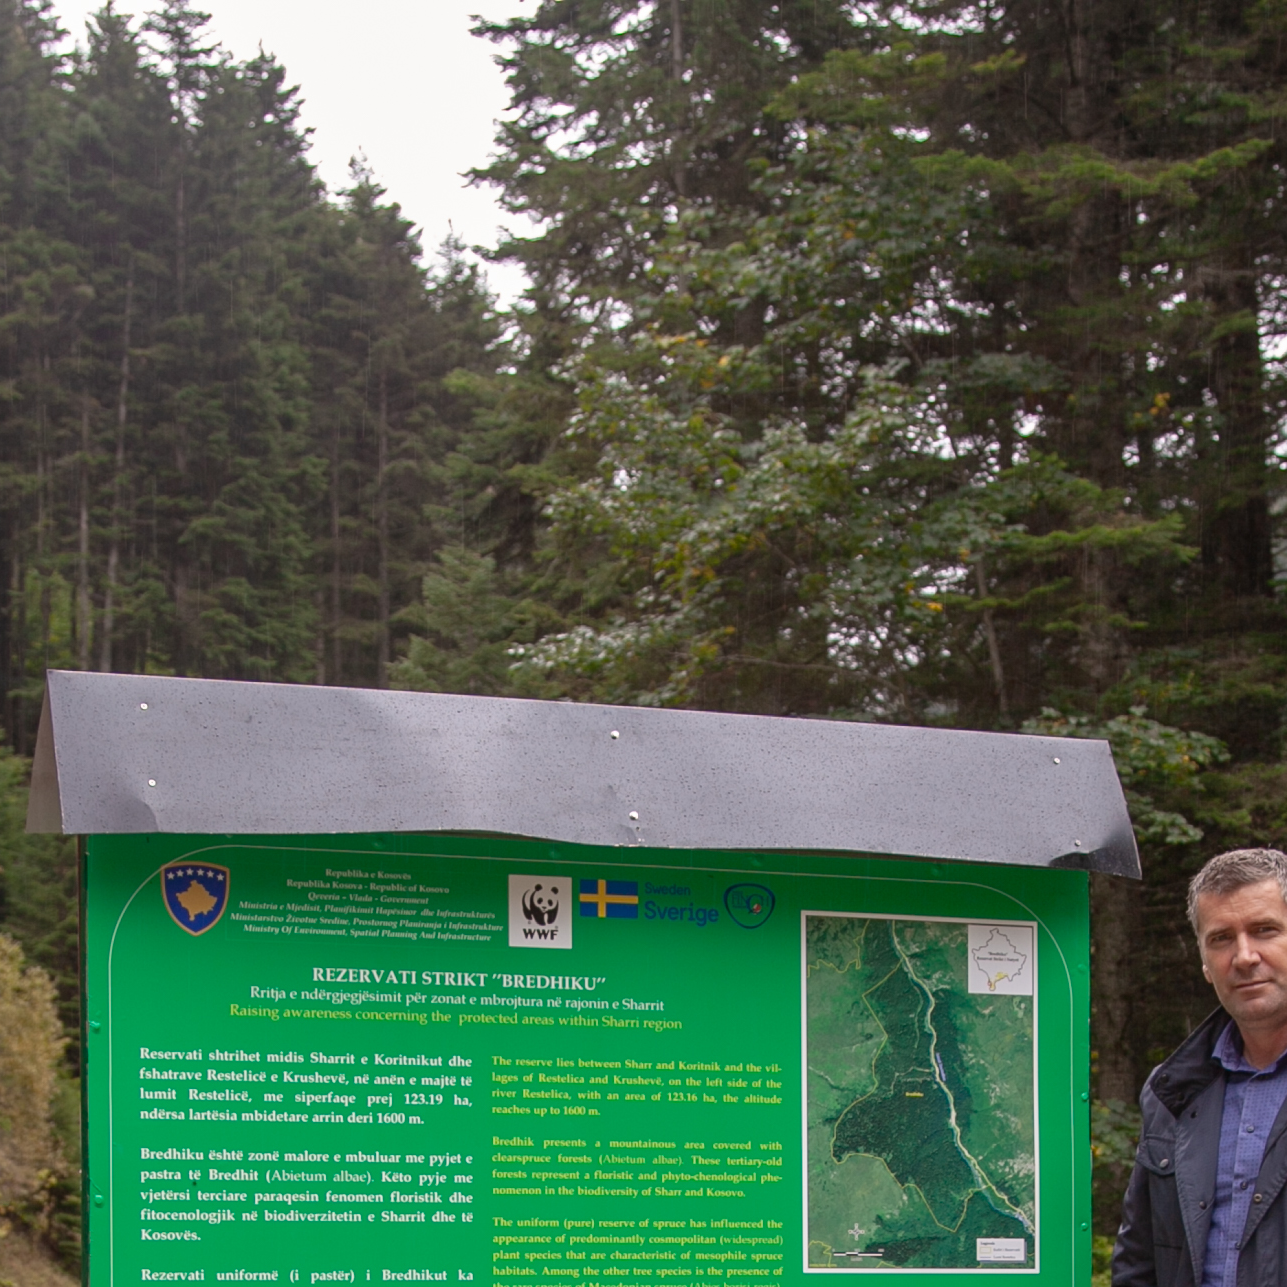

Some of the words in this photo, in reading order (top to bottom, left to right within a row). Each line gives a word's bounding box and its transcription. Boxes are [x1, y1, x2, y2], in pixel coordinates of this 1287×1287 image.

[644, 882, 691, 897] Sweden
[644, 901, 720, 927] Sverige
[522, 928, 559, 941] WWF
[312, 967, 416, 984] REZERVATI
[421, 970, 487, 986] STRIKT
[250, 985, 285, 1001] Rritja
[289, 990, 297, 999] e
[300, 987, 401, 1005] ndërgjegjësimit
[405, 992, 427, 1006] për
[430, 994, 465, 1004] zonat
[469, 996, 477, 1004] e
[480, 993, 543, 1009] mbrojtura
[546, 996, 561, 1007] në
[565, 999, 609, 1011] rajonin
[611, 1000, 619, 1009] e
[621, 998, 663, 1010] Sharrit
[229, 1003, 279, 1020] Raising
[282, 1008, 352, 1019] awareness
[355, 1010, 427, 1025] concerning
[431, 1009, 451, 1022] the
[458, 1012, 517, 1026] protected
[521, 1015, 554, 1025] areas
[558, 1014, 598, 1026] within
[601, 1015, 639, 1027] Sharri
[643, 1019, 682, 1032] region
[139, 1047, 202, 1060] Reservati
[208, 1048, 260, 1062] shtrihet
[266, 1051, 304, 1062] midis
[309, 1051, 355, 1064] Sharrit
[360, 1056, 368, 1064] e
[374, 1053, 442, 1066] Koritnikut
[448, 1055, 472, 1067] dhe
[491, 1055, 511, 1065] The
[515, 1058, 552, 1066] reserve
[556, 1057, 574, 1067] lies
[577, 1057, 621, 1068] between
[624, 1059, 652, 1069] Sharr
[655, 1060, 675, 1070] and
[678, 1060, 721, 1071] Koritnik
[723, 1062, 743, 1071] and
[745, 1062, 761, 1072] the
[765, 1063, 781, 1072] vil-
[139, 1066, 202, 1080] fshatrave
[207, 1068, 266, 1082] Restelicë
[270, 1073, 278, 1082] e
[283, 1070, 349, 1085] Krushevë,
[353, 1073, 369, 1084] në
[373, 1074, 405, 1085] anën
[409, 1076, 416, 1085] e
[421, 1074, 456, 1089] majtë
[460, 1076, 472, 1086] të
[491, 1071, 518, 1084] lages
[522, 1072, 533, 1082] of
[538, 1072, 584, 1083] Restelica
[588, 1074, 608, 1084] and
[685, 1076, 701, 1086] the
[705, 1076, 722, 1086] left
[726, 1077, 747, 1087] side
[751, 1078, 761, 1087] of
[765, 1079, 782, 1088] the
[139, 1087, 176, 1099] lumit
[188, 1088, 251, 1102] Restelicë,
[263, 1093, 283, 1102] me
[294, 1090, 355, 1106] siperfaqe
[367, 1092, 392, 1107] prej
[404, 1092, 443, 1105] 123.19
[453, 1093, 472, 1106] ha,
[491, 1088, 516, 1097] river
[522, 1088, 571, 1100] Restelica,
[577, 1090, 601, 1099] with
[606, 1092, 619, 1100] an
[650, 1091, 661, 1101] of
[667, 1091, 697, 1101] 123.16
[702, 1092, 717, 1103] ha,
[722, 1093, 738, 1102] the
[743, 1093, 782, 1104] altitude
[139, 1107, 185, 1119] ndërsa
[188, 1108, 237, 1120] lartësia
[241, 1109, 308, 1122] mbidetare
[311, 1111, 343, 1122] arrin
[347, 1111, 373, 1123] deri
[376, 1112, 405, 1123] 1600
[408, 1115, 424, 1124] m.
[491, 1104, 531, 1114] reaches
[533, 1107, 547, 1117] up
[549, 1106, 560, 1114] to
[563, 1105, 585, 1115] 1600
[140, 1188, 190, 1203] vjetërsi
[197, 1189, 247, 1201] terciare
[254, 1190, 319, 1205] paraqesin
[325, 1190, 383, 1202] fenomen
[389, 1190, 442, 1202] floristik
[448, 1191, 473, 1203] dhe
[141, 1268, 204, 1280] Rezervati
[216, 1268, 278, 1280] uniformë
[289, 1269, 299, 1282] (i
[310, 1269, 354, 1284] pastër)
[365, 1269, 370, 1280] i
[381, 1268, 447, 1280] Bredhikut
[457, 1268, 473, 1280] ka
